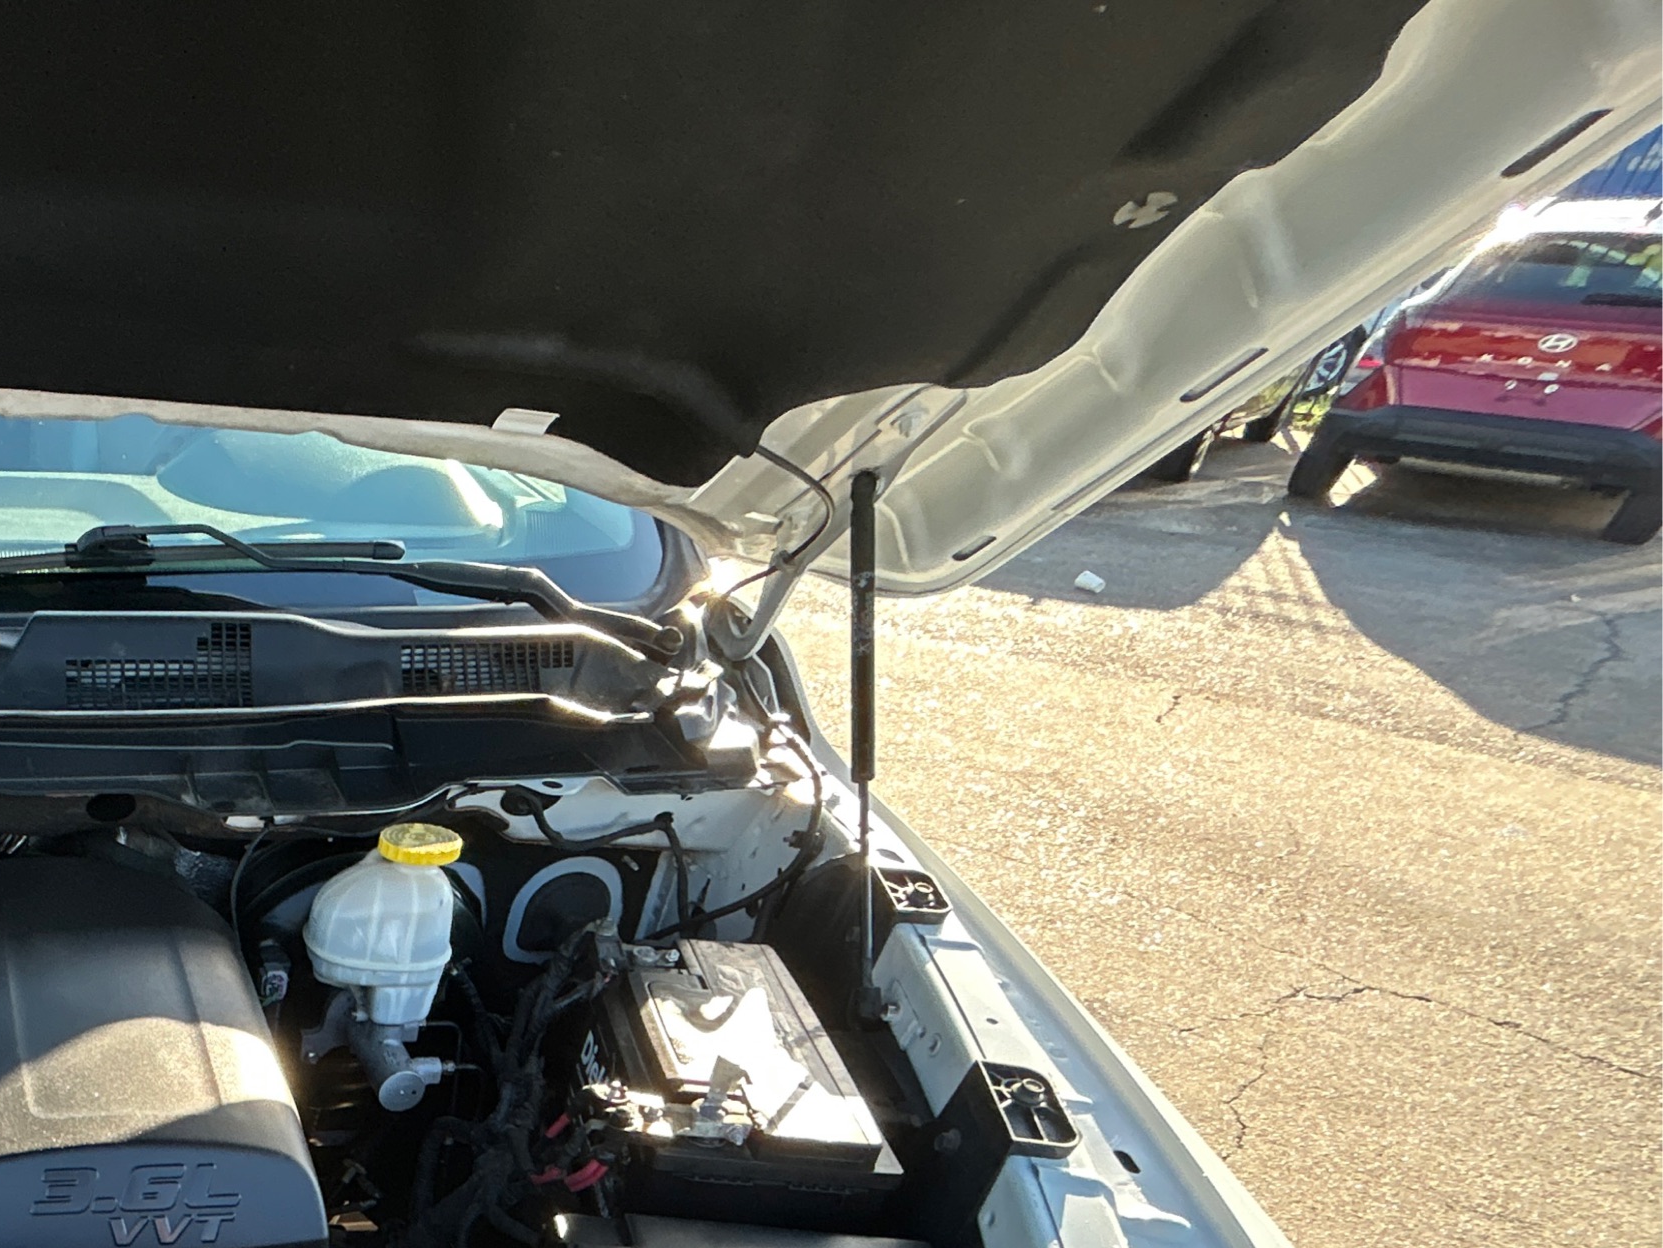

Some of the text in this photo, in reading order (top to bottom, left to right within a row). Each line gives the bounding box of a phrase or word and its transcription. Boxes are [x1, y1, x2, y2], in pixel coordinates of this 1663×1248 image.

[1478, 353, 1612, 371] KONA
[29, 1162, 242, 1216] 3.6L
[109, 1212, 236, 1248] VVT
